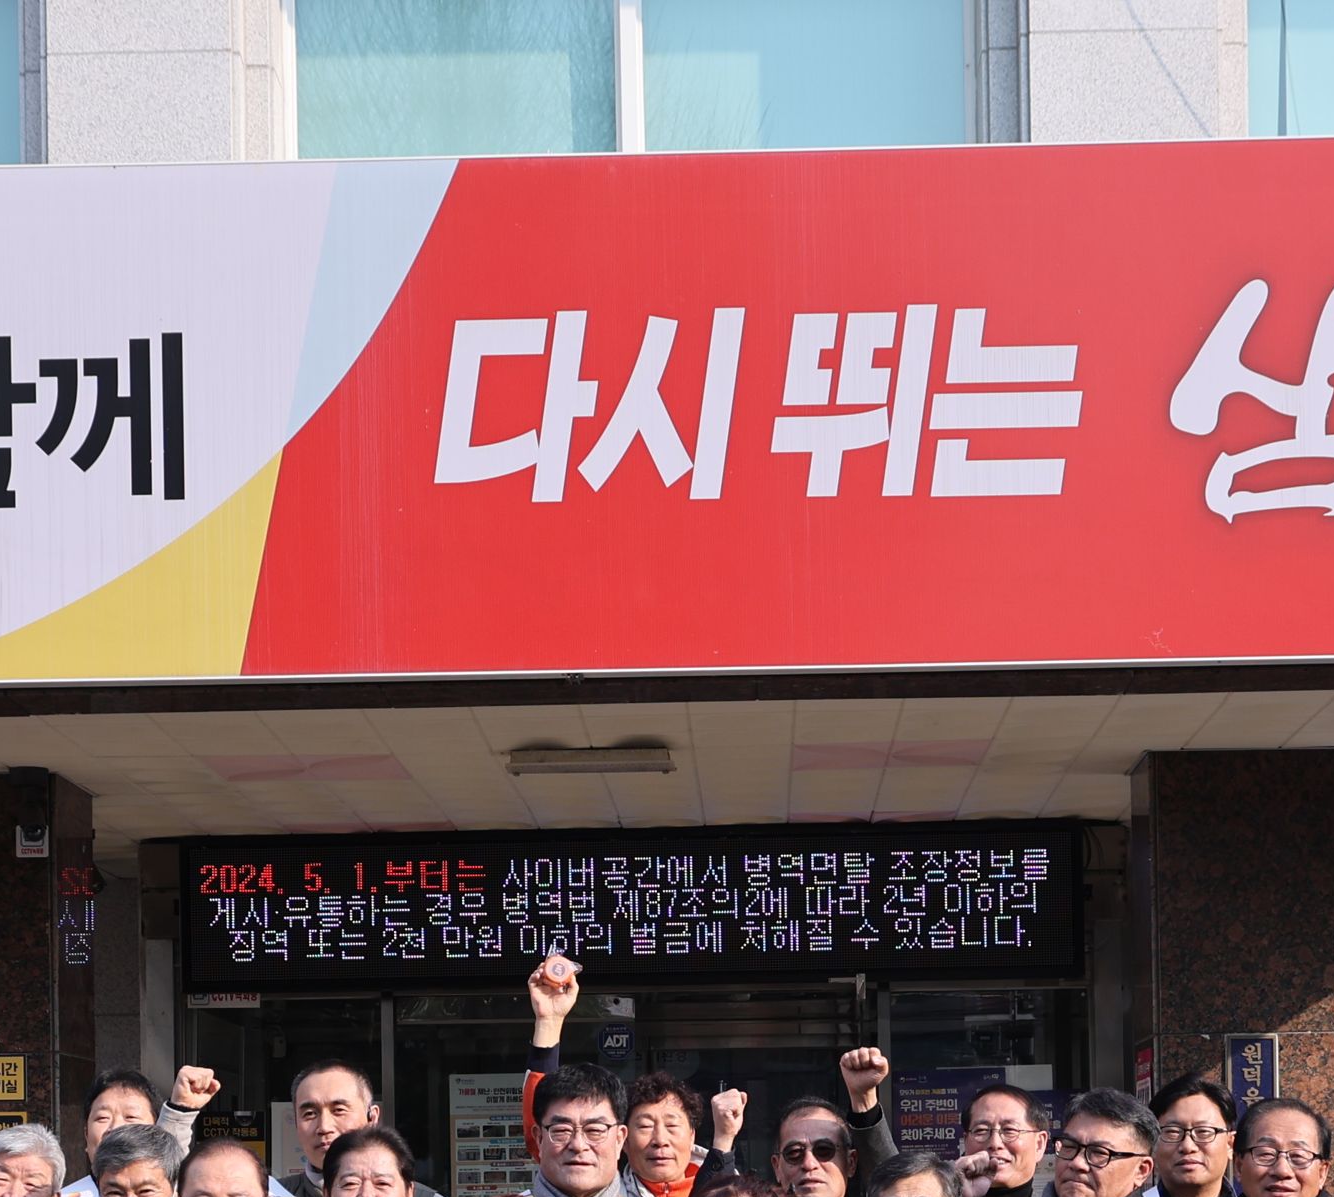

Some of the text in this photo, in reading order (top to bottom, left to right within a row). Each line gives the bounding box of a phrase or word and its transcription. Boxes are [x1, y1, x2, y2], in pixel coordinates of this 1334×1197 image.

[433, 306, 745, 504] 다시
[769, 303, 1082, 498] 뛰는
[200, 863, 284, 894] 2024.
[305, 862, 330, 894] 5.
[744, 852, 875, 886] 병역면탈
[891, 848, 1049, 881] 조장정보를
[426, 892, 487, 926] 경우
[503, 889, 594, 922] 병역법
[805, 884, 871, 917] 따라
[883, 884, 926, 917] 2년
[944, 881, 1037, 914] 이하의
[228, 915, 1033, 962] 징역 또는 2천 만원 이하의 벌금에 처해질 수 있습니다.
[604, 1035, 629, 1049] ADT
[900, 1098, 958, 1112] 우리 주변의
[936, 1112, 962, 1126] 이웃
[203, 1128, 230, 1137] CCTV
[900, 1127, 956, 1142] 찾아주세요
